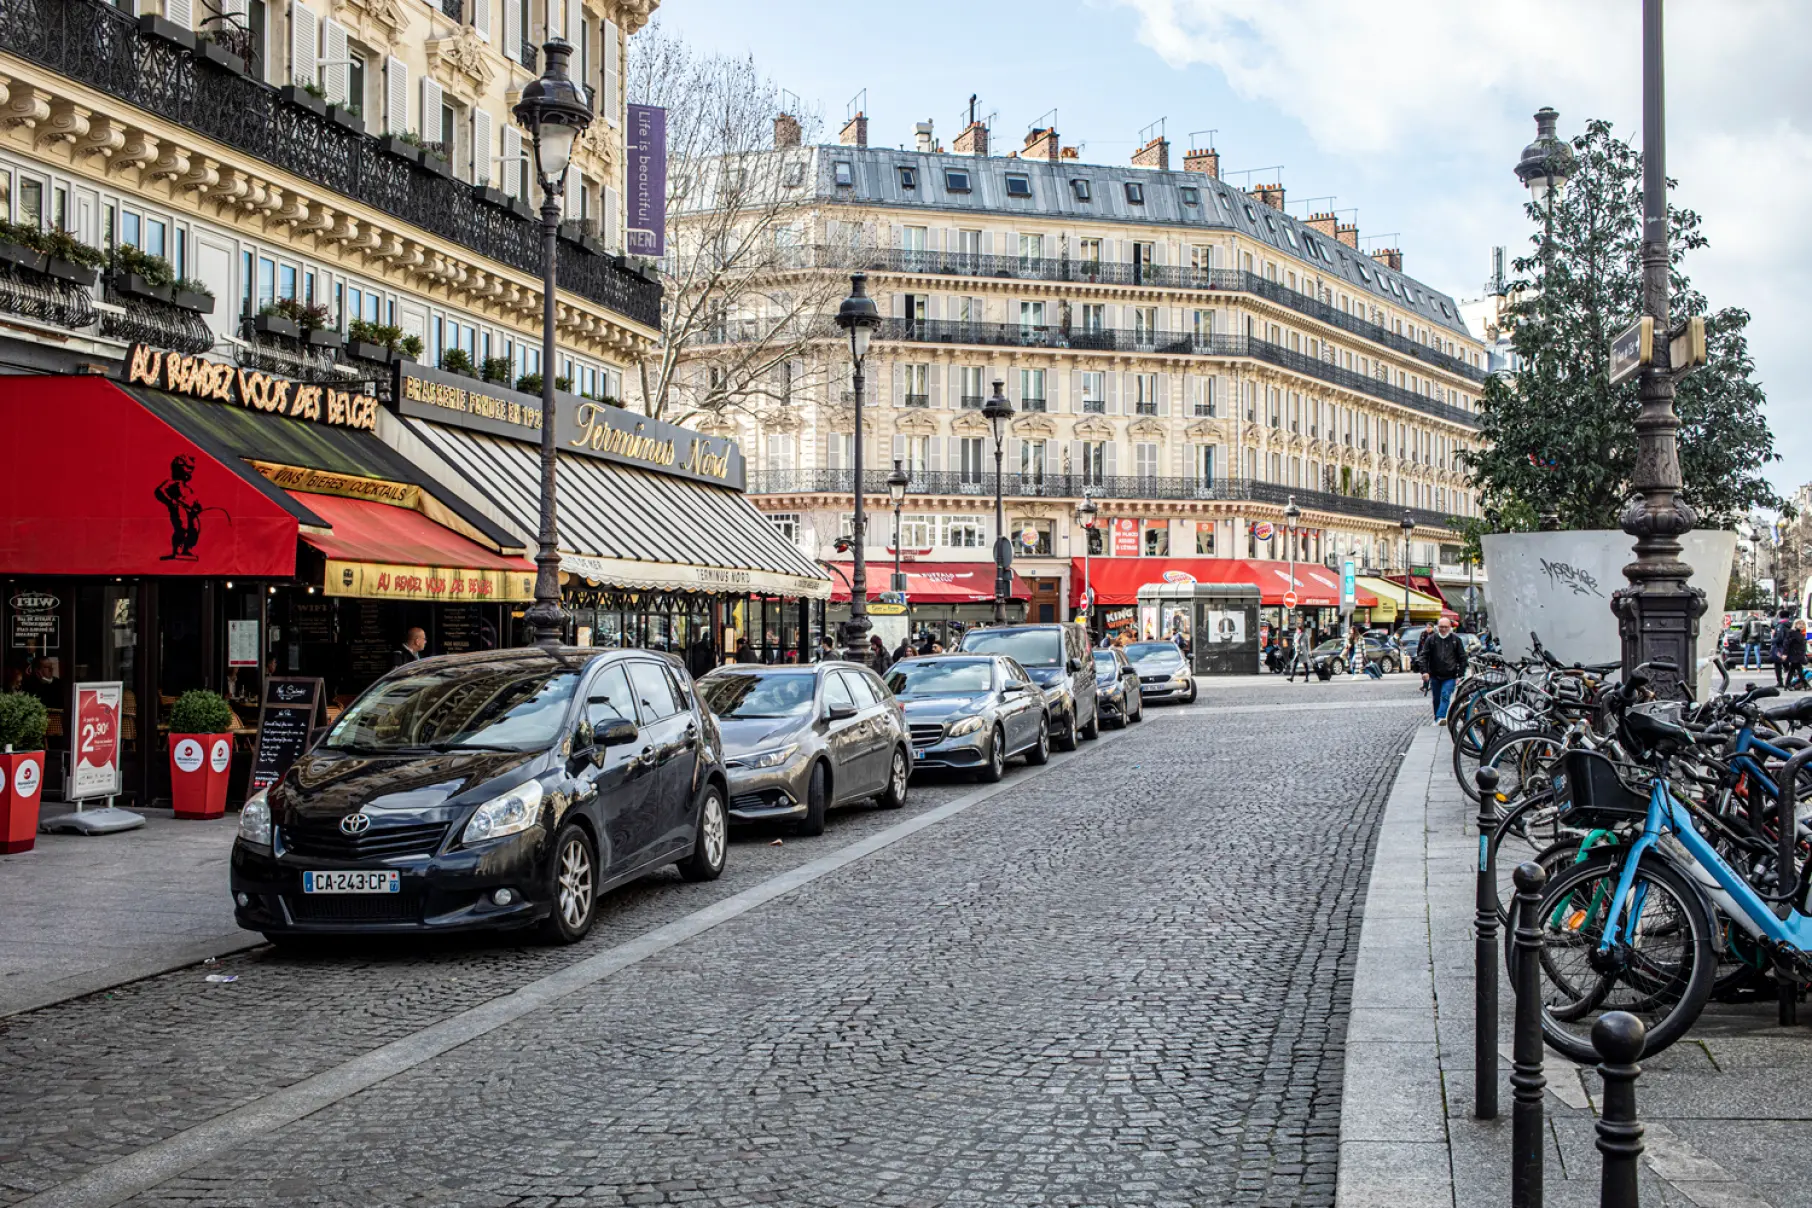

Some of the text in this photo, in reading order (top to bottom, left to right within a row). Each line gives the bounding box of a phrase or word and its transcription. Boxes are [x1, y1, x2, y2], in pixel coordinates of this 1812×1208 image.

[638, 111, 651, 226] Life is beautiful.
[129, 343, 379, 430] AU RENDEZ VOUS DES BELGES
[406, 375, 466, 412] BRASSERIE
[507, 401, 521, 425] EN
[569, 402, 732, 479] Terminus Nord
[273, 468, 303, 485] VINS
[306, 475, 346, 490] BIERES
[350, 481, 408, 501] COCKTAILS
[377, 572, 494, 595] AU RENDEZ VOUS DES BELGES
[696, 569, 751, 584] TERMINUS NORD
[1105, 608, 1134, 623] KING
[315, 874, 387, 890] CA-243-CP
[390, 881, 399, 890] 77
